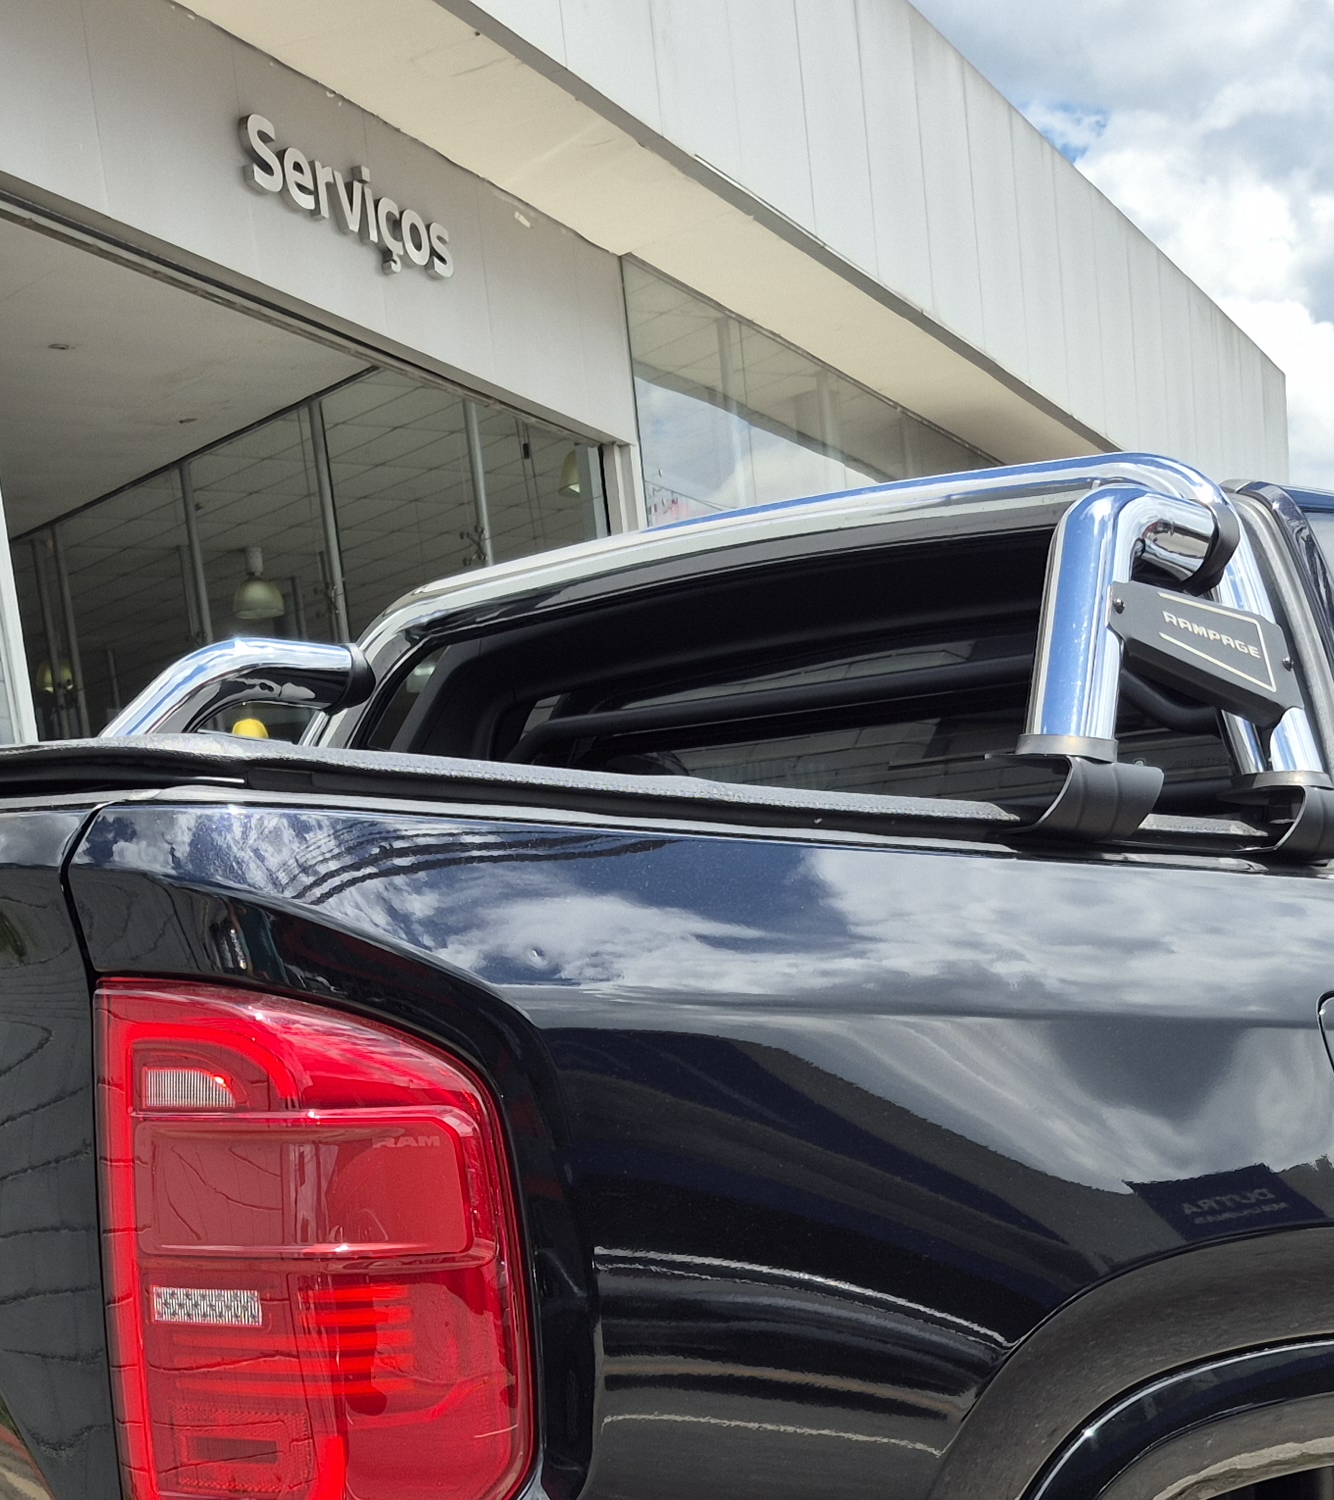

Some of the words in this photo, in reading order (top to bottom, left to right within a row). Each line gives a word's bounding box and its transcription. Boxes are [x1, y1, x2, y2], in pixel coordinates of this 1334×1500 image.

[239, 114, 454, 276] Serviços
[1162, 610, 1261, 659] RAMPAGE
[371, 1135, 441, 1148] RAM
